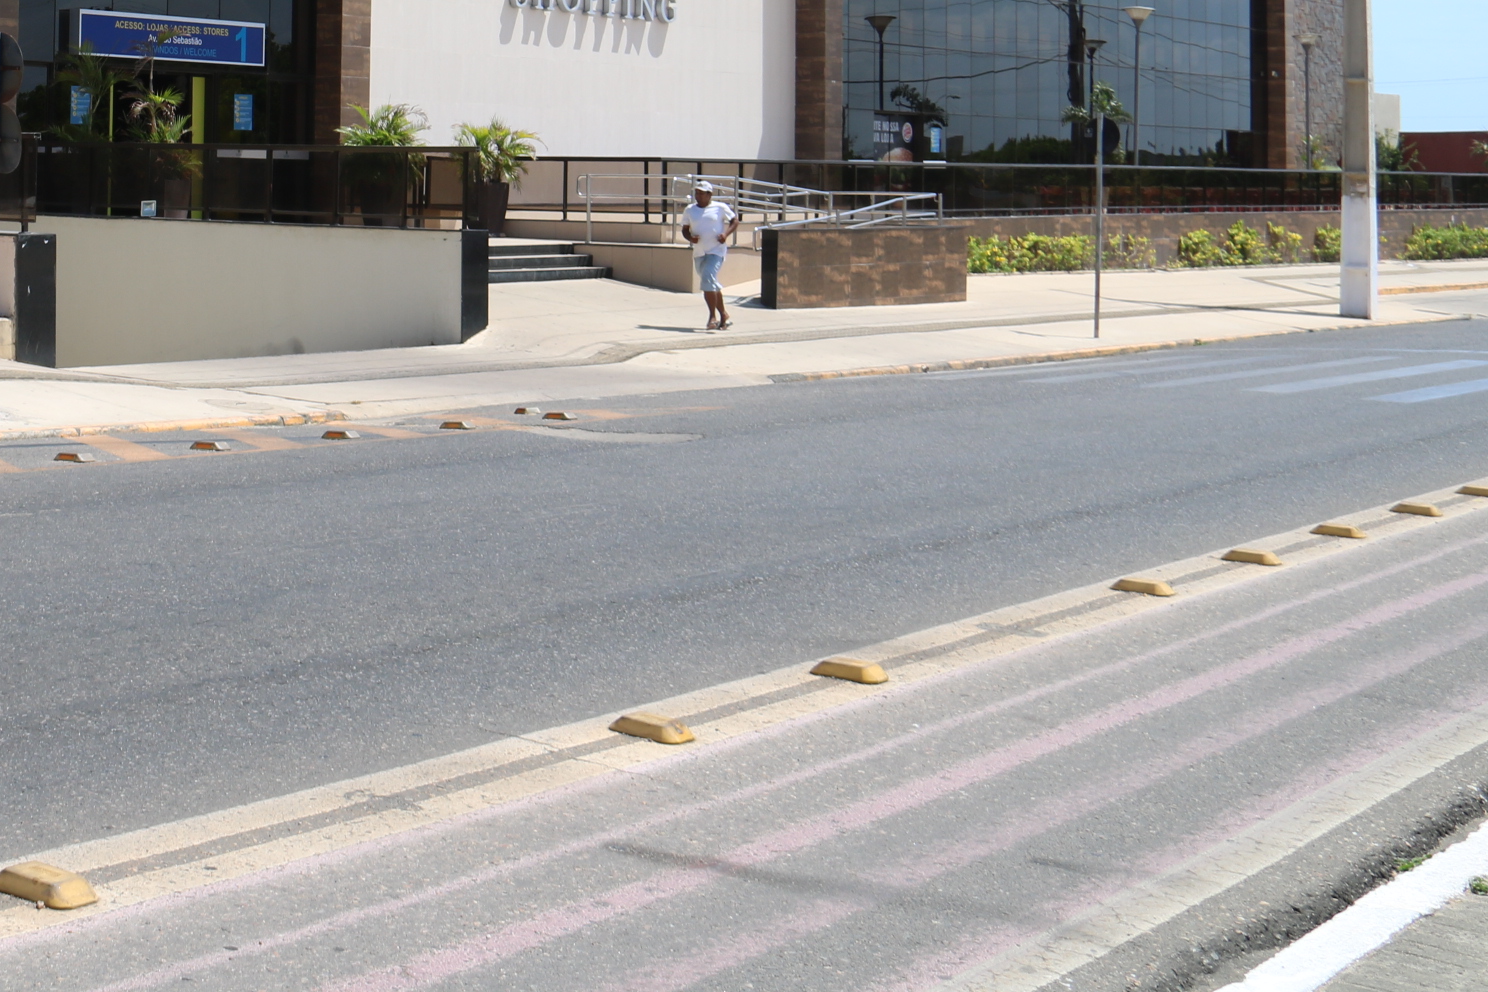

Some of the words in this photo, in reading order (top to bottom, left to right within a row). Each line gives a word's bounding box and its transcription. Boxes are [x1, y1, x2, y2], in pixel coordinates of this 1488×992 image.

[115, 20, 145, 31] ACESSO:
[146, 23, 169, 33] LOJAS
[173, 25, 202, 36] ACCESS:
[203, 27, 229, 37] STORES
[172, 35, 203, 46] Sebastião
[235, 27, 247, 63] 1
[183, 48, 217, 58] WELCOME
